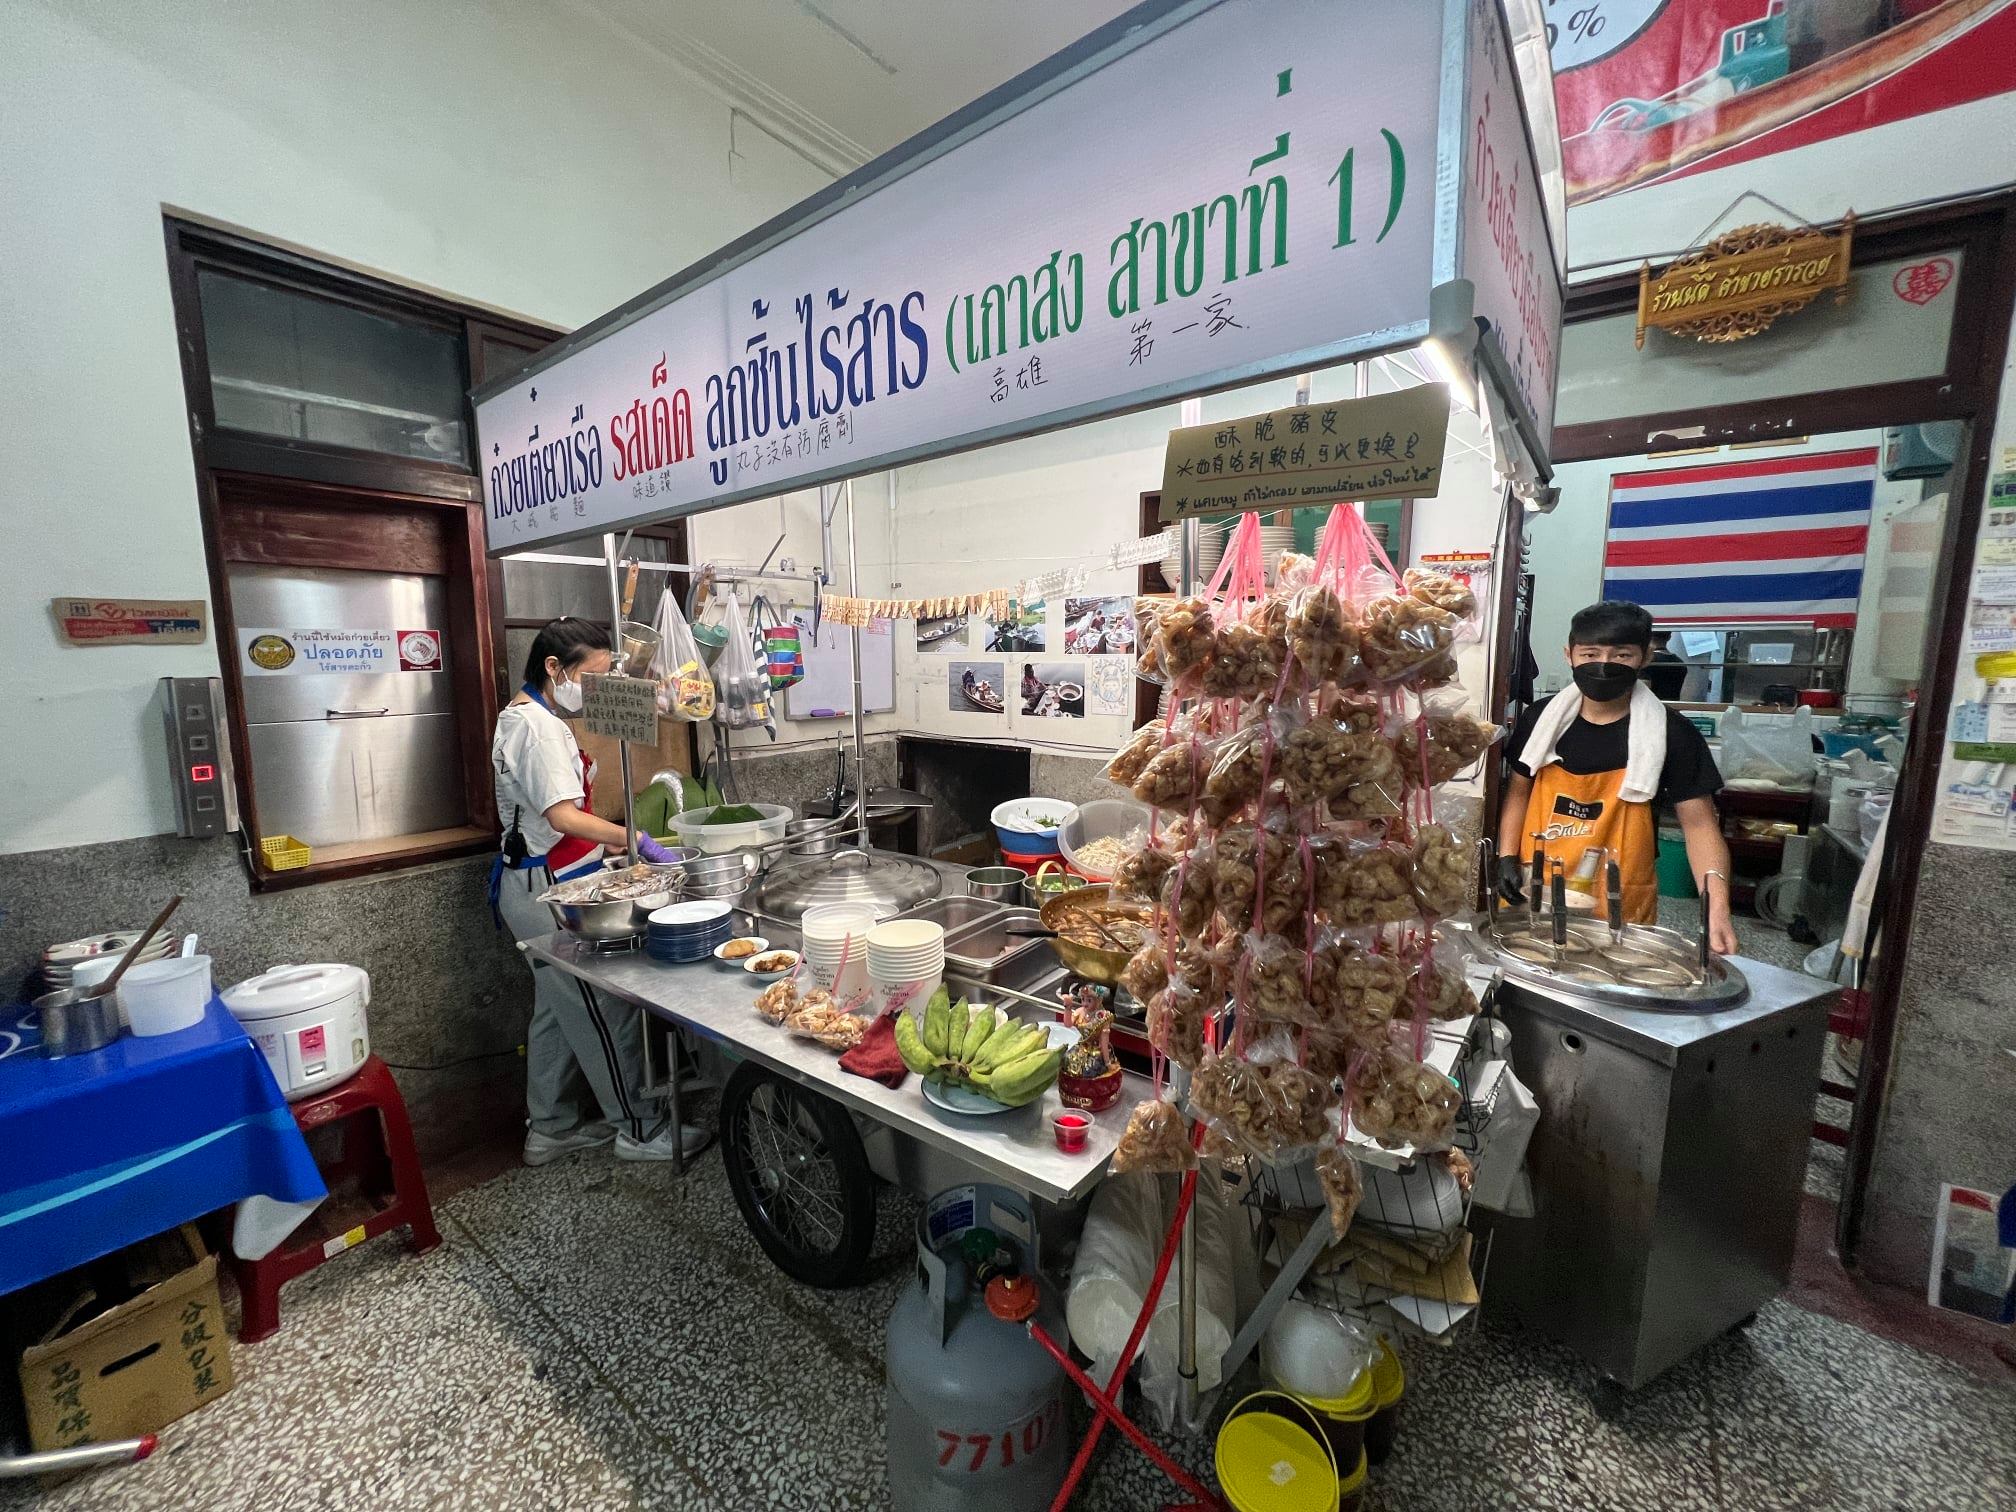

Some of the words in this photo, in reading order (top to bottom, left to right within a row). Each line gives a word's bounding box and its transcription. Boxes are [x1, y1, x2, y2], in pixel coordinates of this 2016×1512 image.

[491, 387, 603, 520] ก๋วยเตี๋ยวเรือ
[610, 350, 696, 482] รสเด็ด
[705, 287, 929, 486] ลูกชิ้นไร้สาร
[945, 249, 1084, 373] (เกาสง
[1107, 67, 1293, 319] สาขาที่
[736, 411, 855, 472] 丸子沒有防腐劑
[990, 354, 1049, 403] 高雄
[1214, 409, 1339, 449] 酥脆豬皮
[303, 643, 383, 660] ปลอดภัย
[936, 1402, 1062, 1472] 7710
